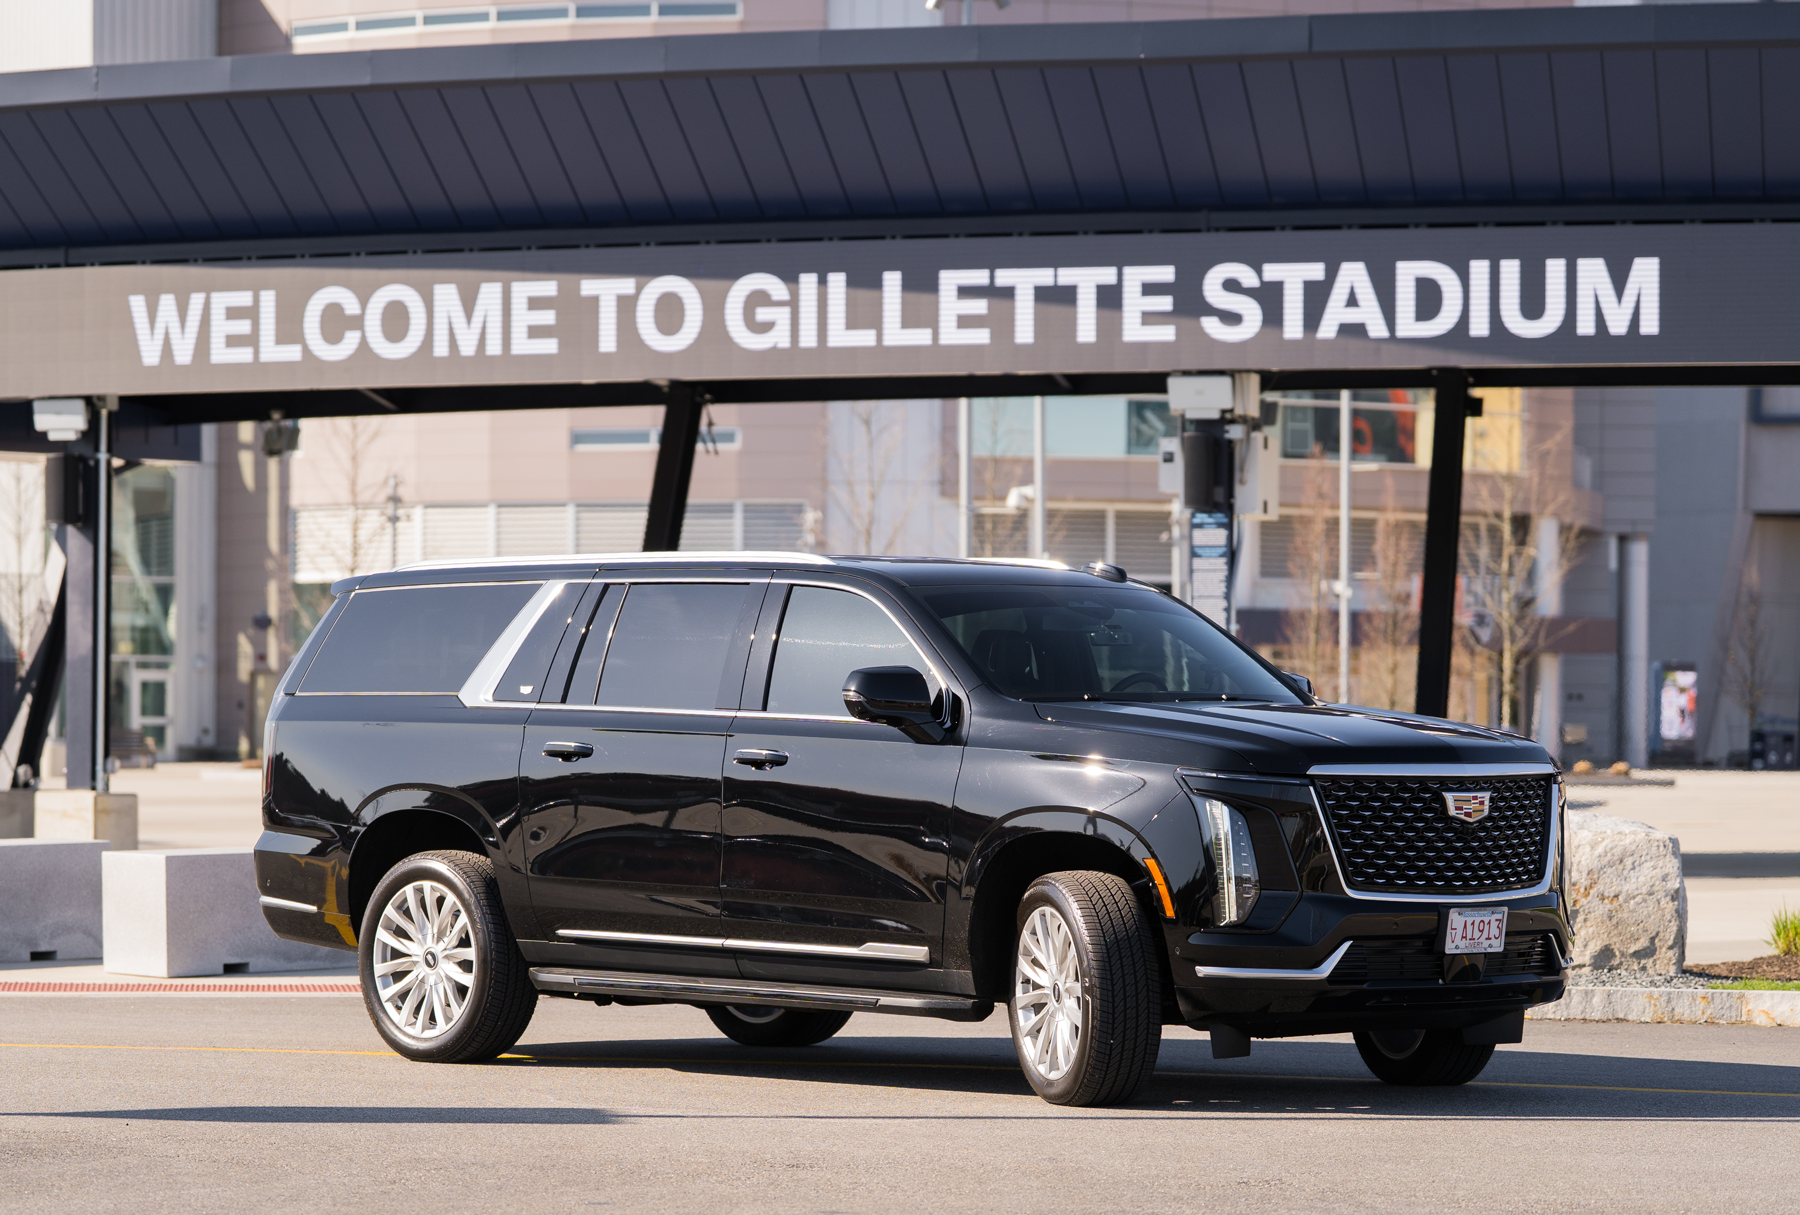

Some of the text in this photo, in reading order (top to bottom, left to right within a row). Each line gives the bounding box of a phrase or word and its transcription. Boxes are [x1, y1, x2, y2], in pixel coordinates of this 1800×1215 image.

[128, 257, 1660, 367] WELCOME TO GILLETTE STADIUM
[1461, 919, 1502, 941] A1913
